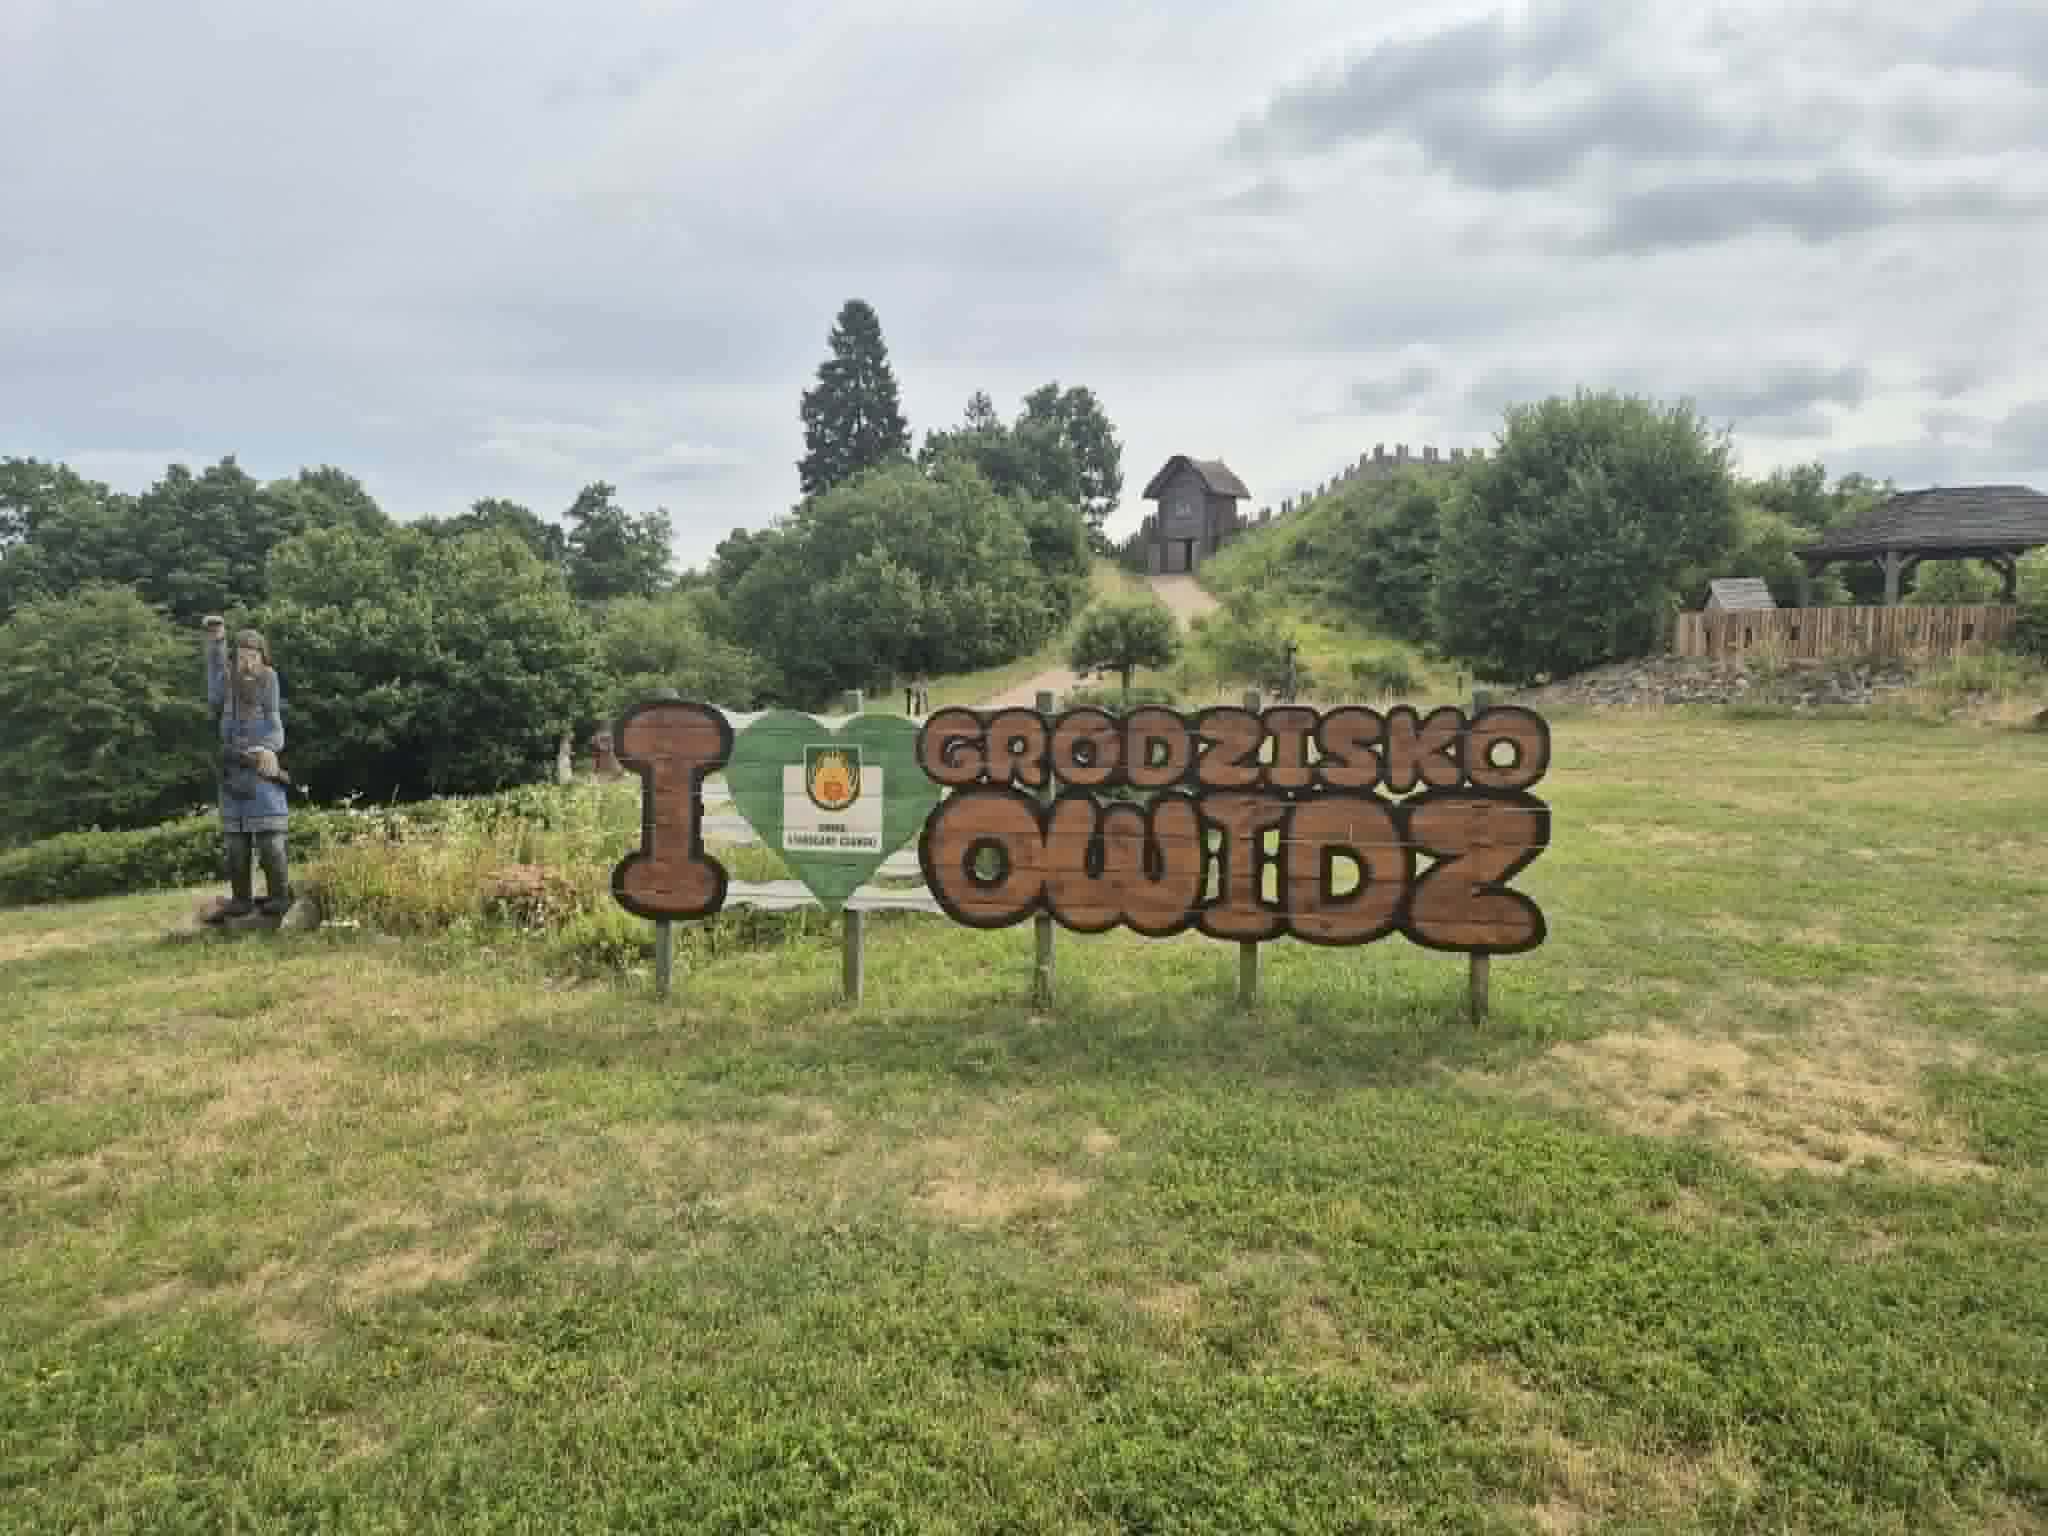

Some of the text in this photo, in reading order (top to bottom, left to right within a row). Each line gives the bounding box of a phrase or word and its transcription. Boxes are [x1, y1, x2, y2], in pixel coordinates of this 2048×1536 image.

[613, 700, 733, 919] I
[917, 706, 1550, 791] GRODZISKO
[920, 790, 1551, 953] OWIDZ
